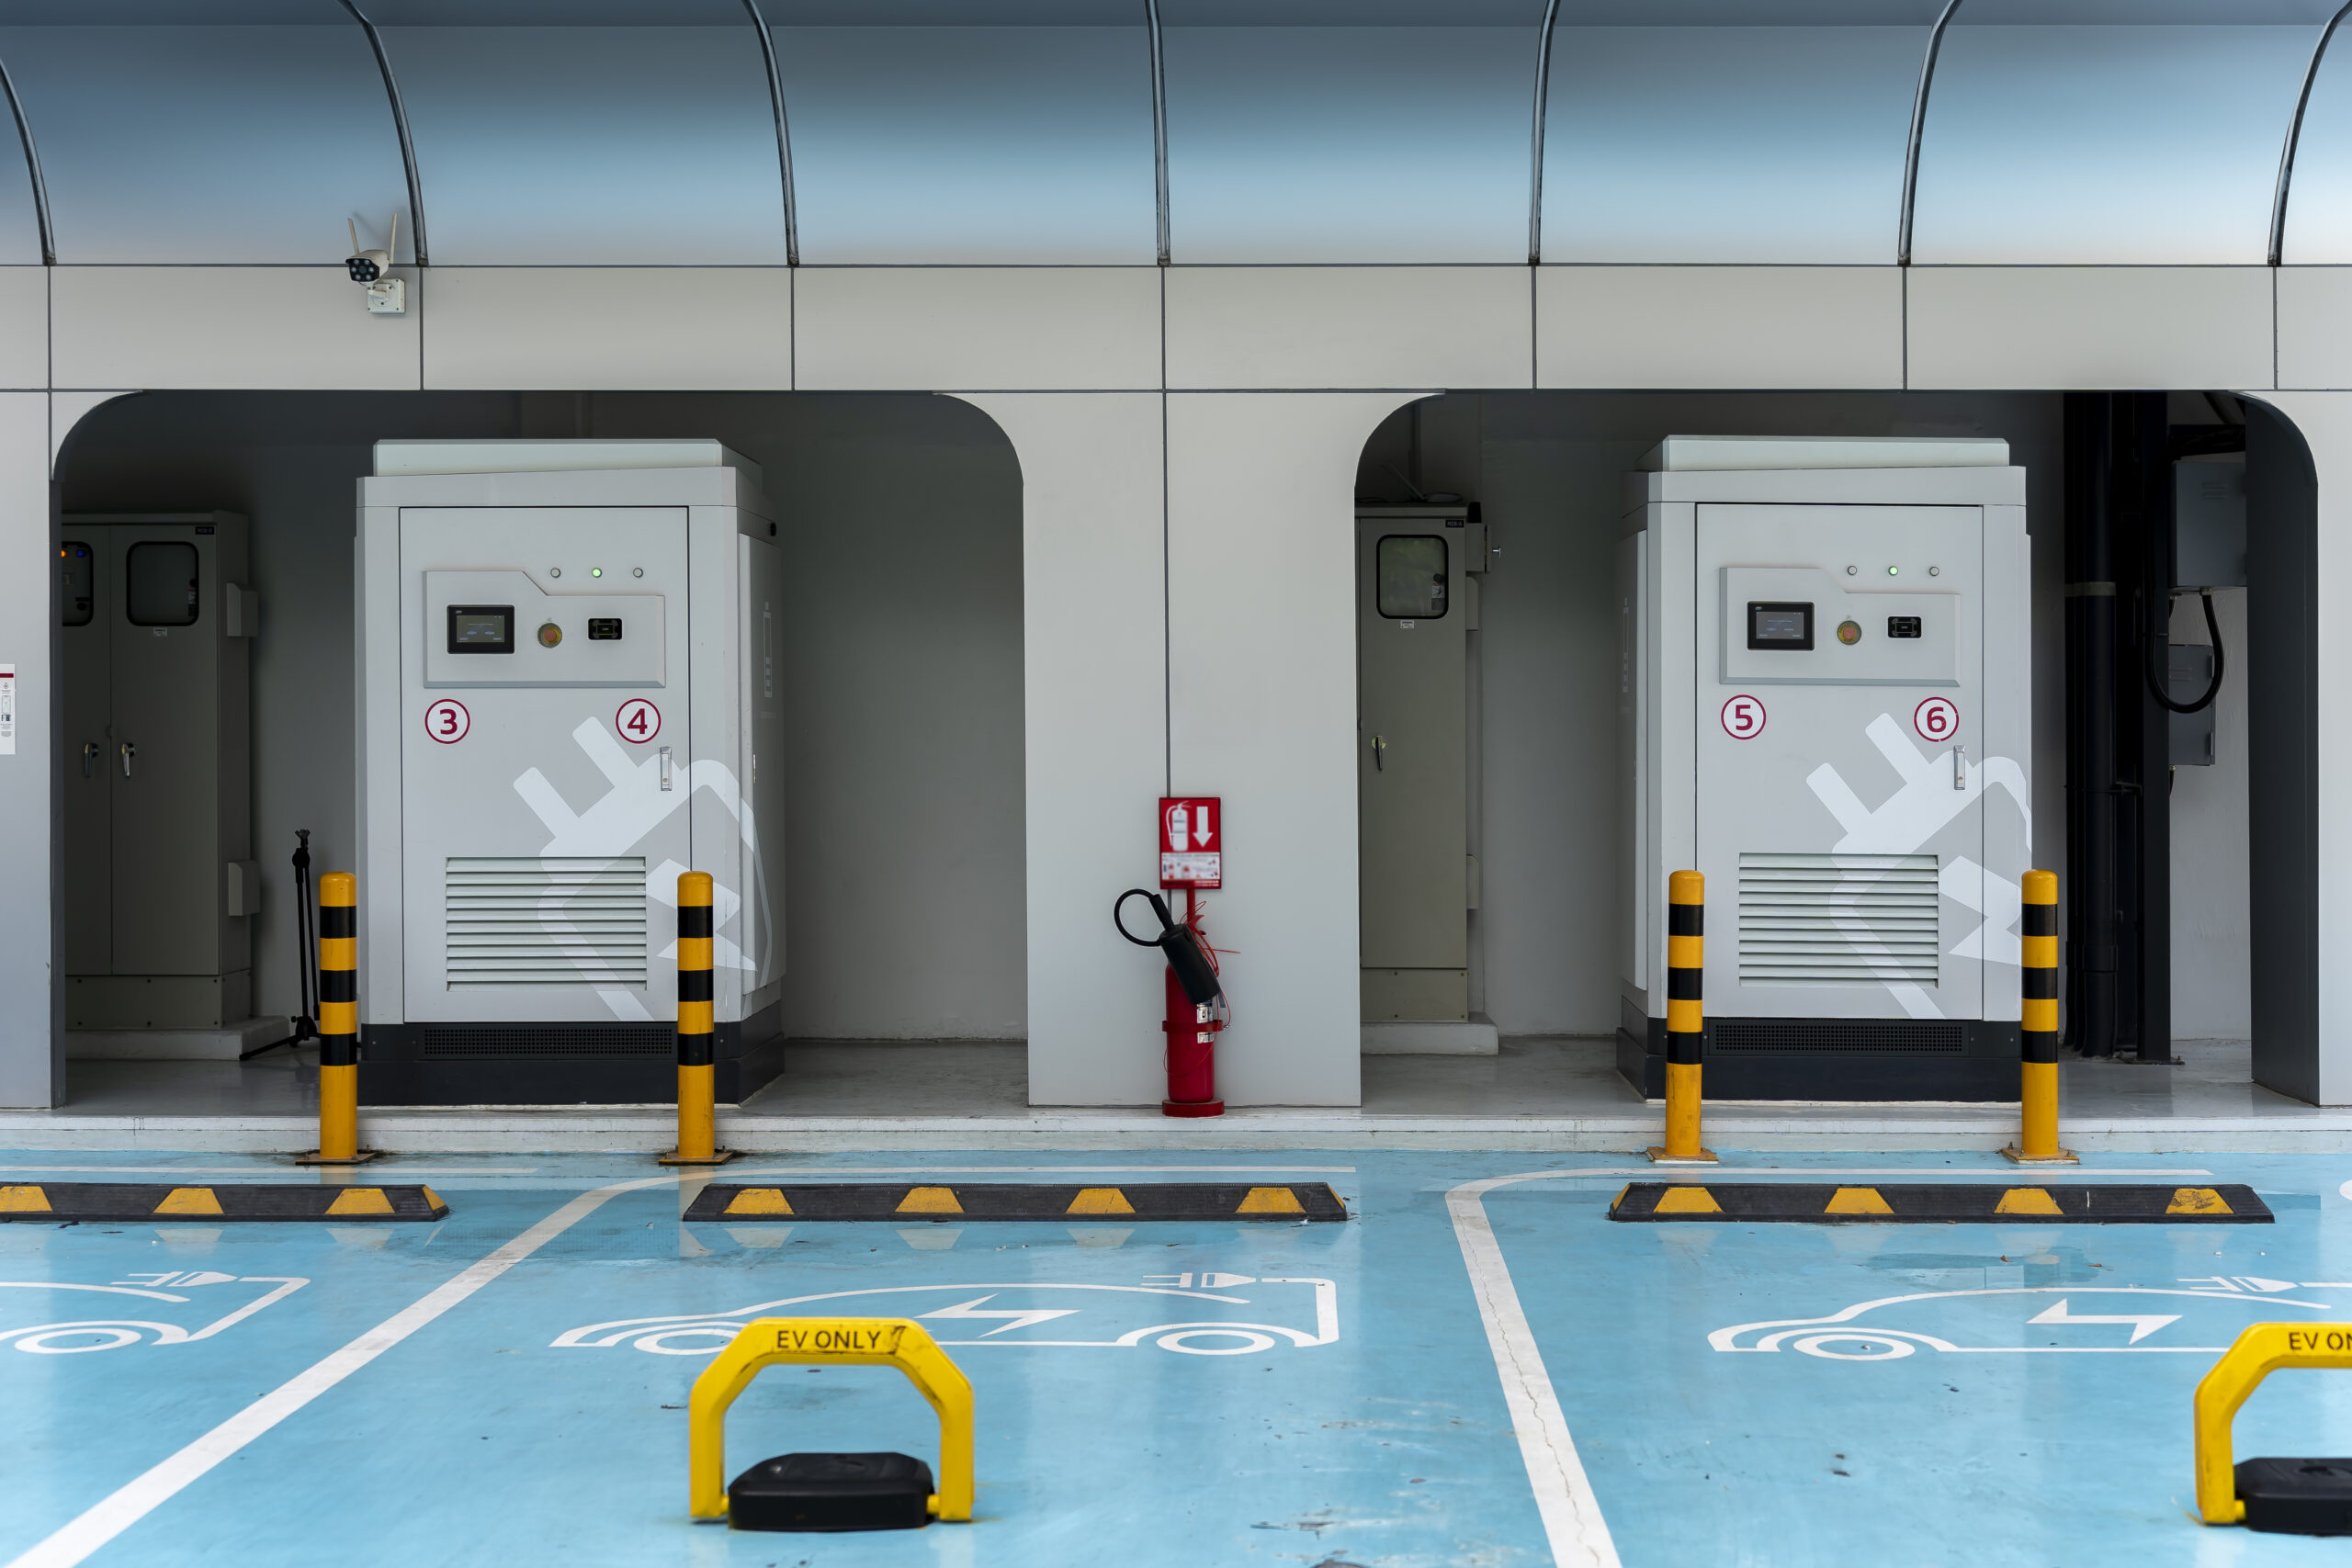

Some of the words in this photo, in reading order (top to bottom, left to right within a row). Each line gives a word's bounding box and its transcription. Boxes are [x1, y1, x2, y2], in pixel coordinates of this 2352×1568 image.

[439, 708, 458, 735] 3
[627, 708, 648, 735] 4
[1735, 704, 1753, 731] 5
[1927, 706, 1947, 733] 6
[776, 1329, 808, 1348] EV
[815, 1329, 881, 1349] ONLY
[2289, 1332, 2318, 1350] EV
